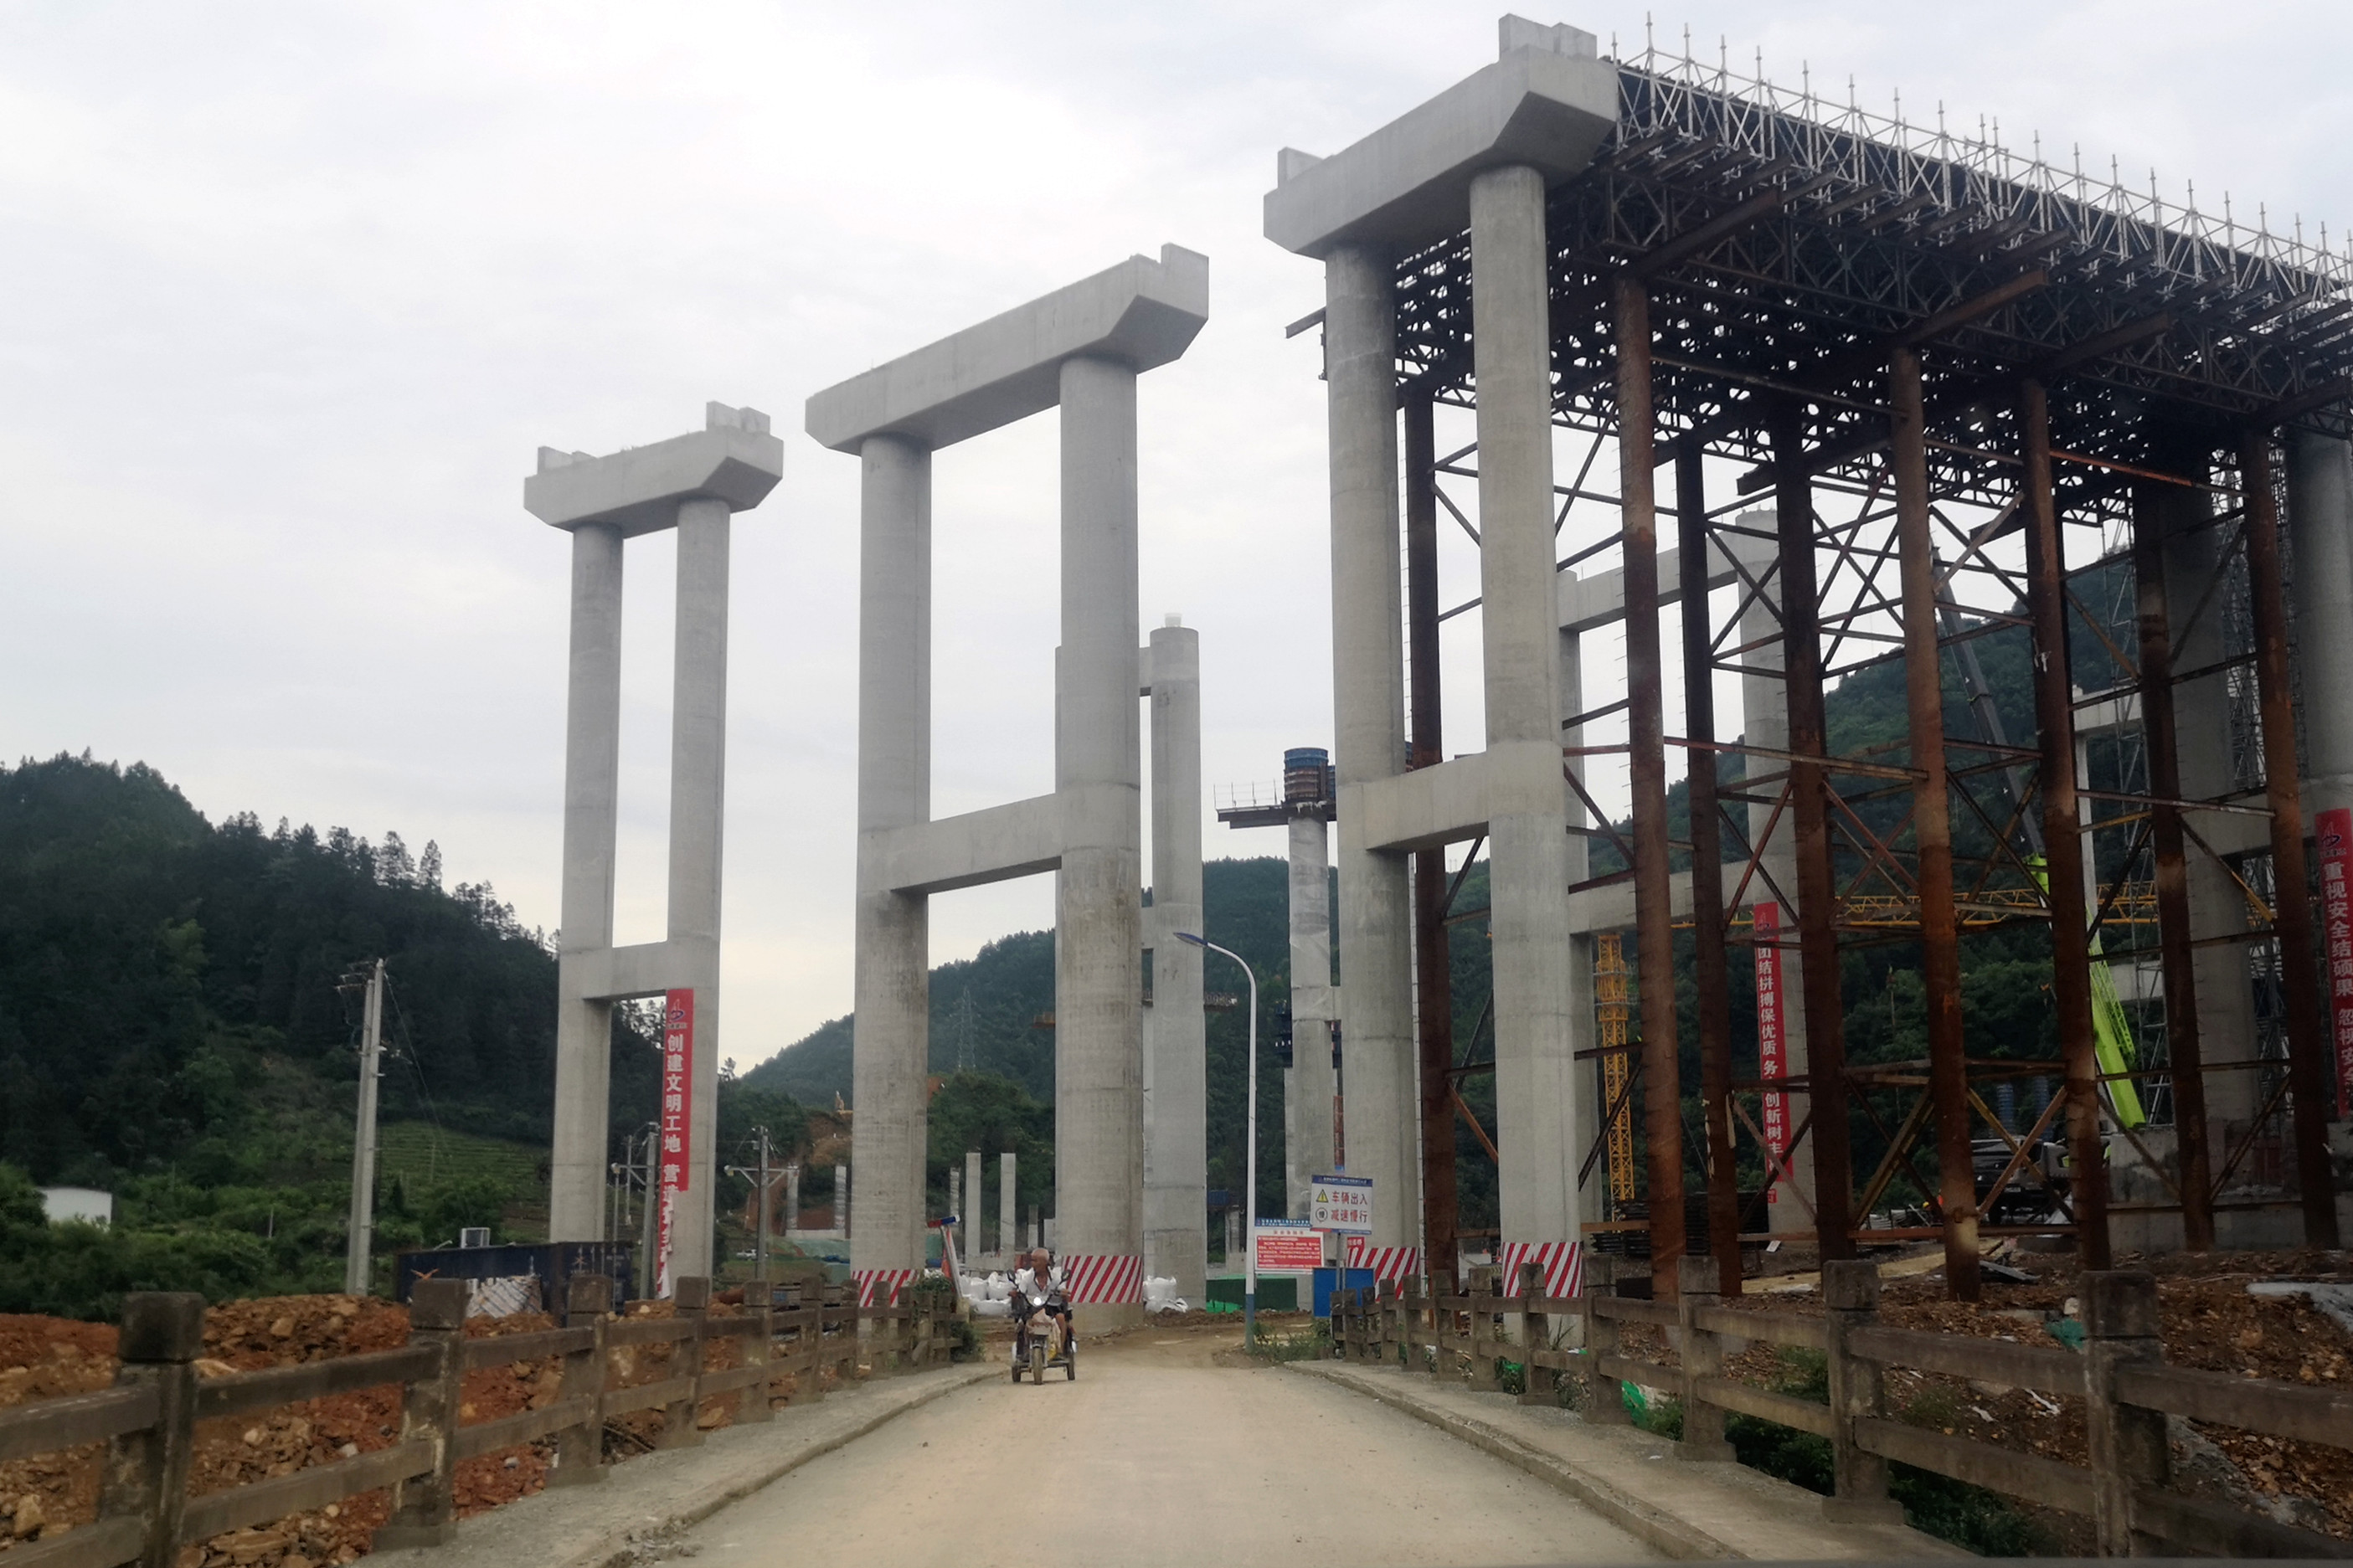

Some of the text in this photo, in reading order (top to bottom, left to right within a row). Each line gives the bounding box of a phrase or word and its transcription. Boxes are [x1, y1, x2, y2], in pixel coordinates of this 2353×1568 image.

[664, 1034, 683, 1153] 创建文明工地
[1331, 1190, 1367, 1206] 车辆出入
[1331, 1209, 1368, 1223] 减速慢行
